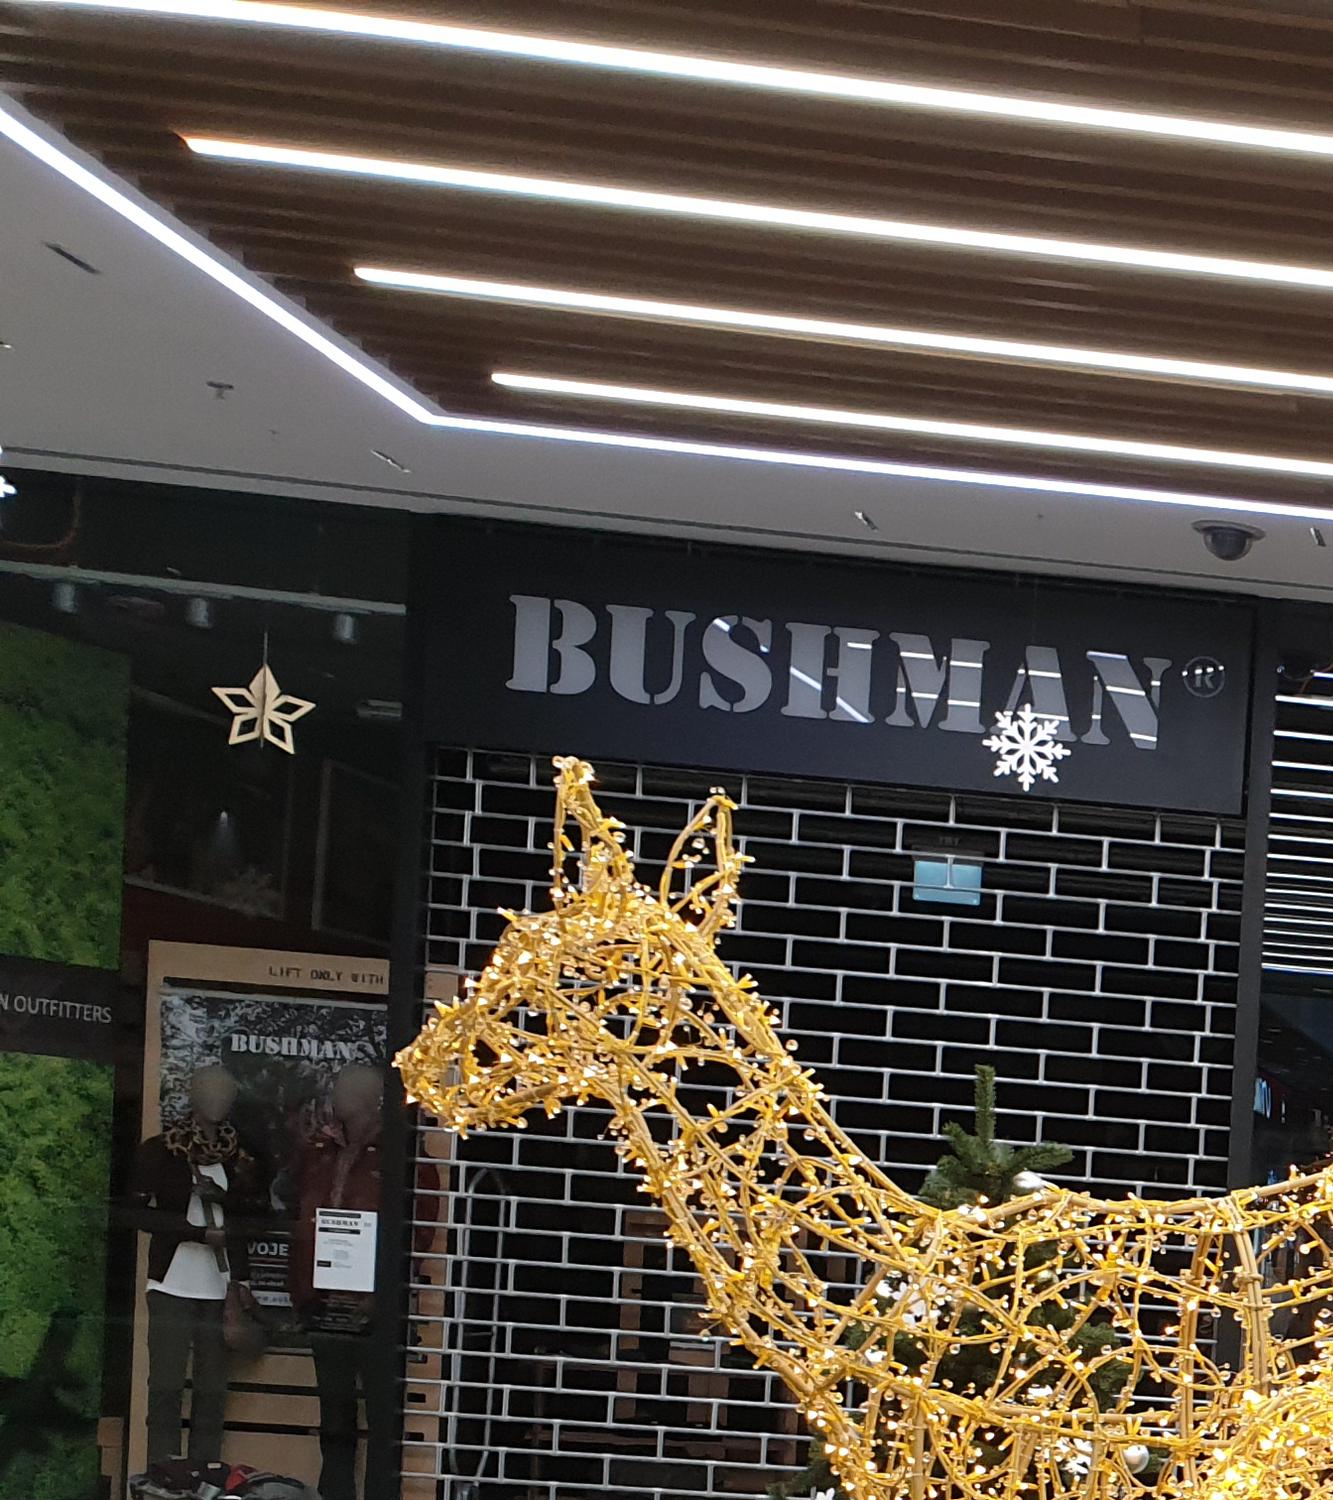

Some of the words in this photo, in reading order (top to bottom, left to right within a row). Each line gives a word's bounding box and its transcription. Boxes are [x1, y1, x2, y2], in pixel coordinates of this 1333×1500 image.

[505, 594, 1172, 750] BUSHMAN
[268, 965, 302, 978] LIFT
[310, 968, 343, 981] ONLY
[13, 995, 113, 1024] OUTFITTERS
[230, 1033, 357, 1061] BUSHMAN
